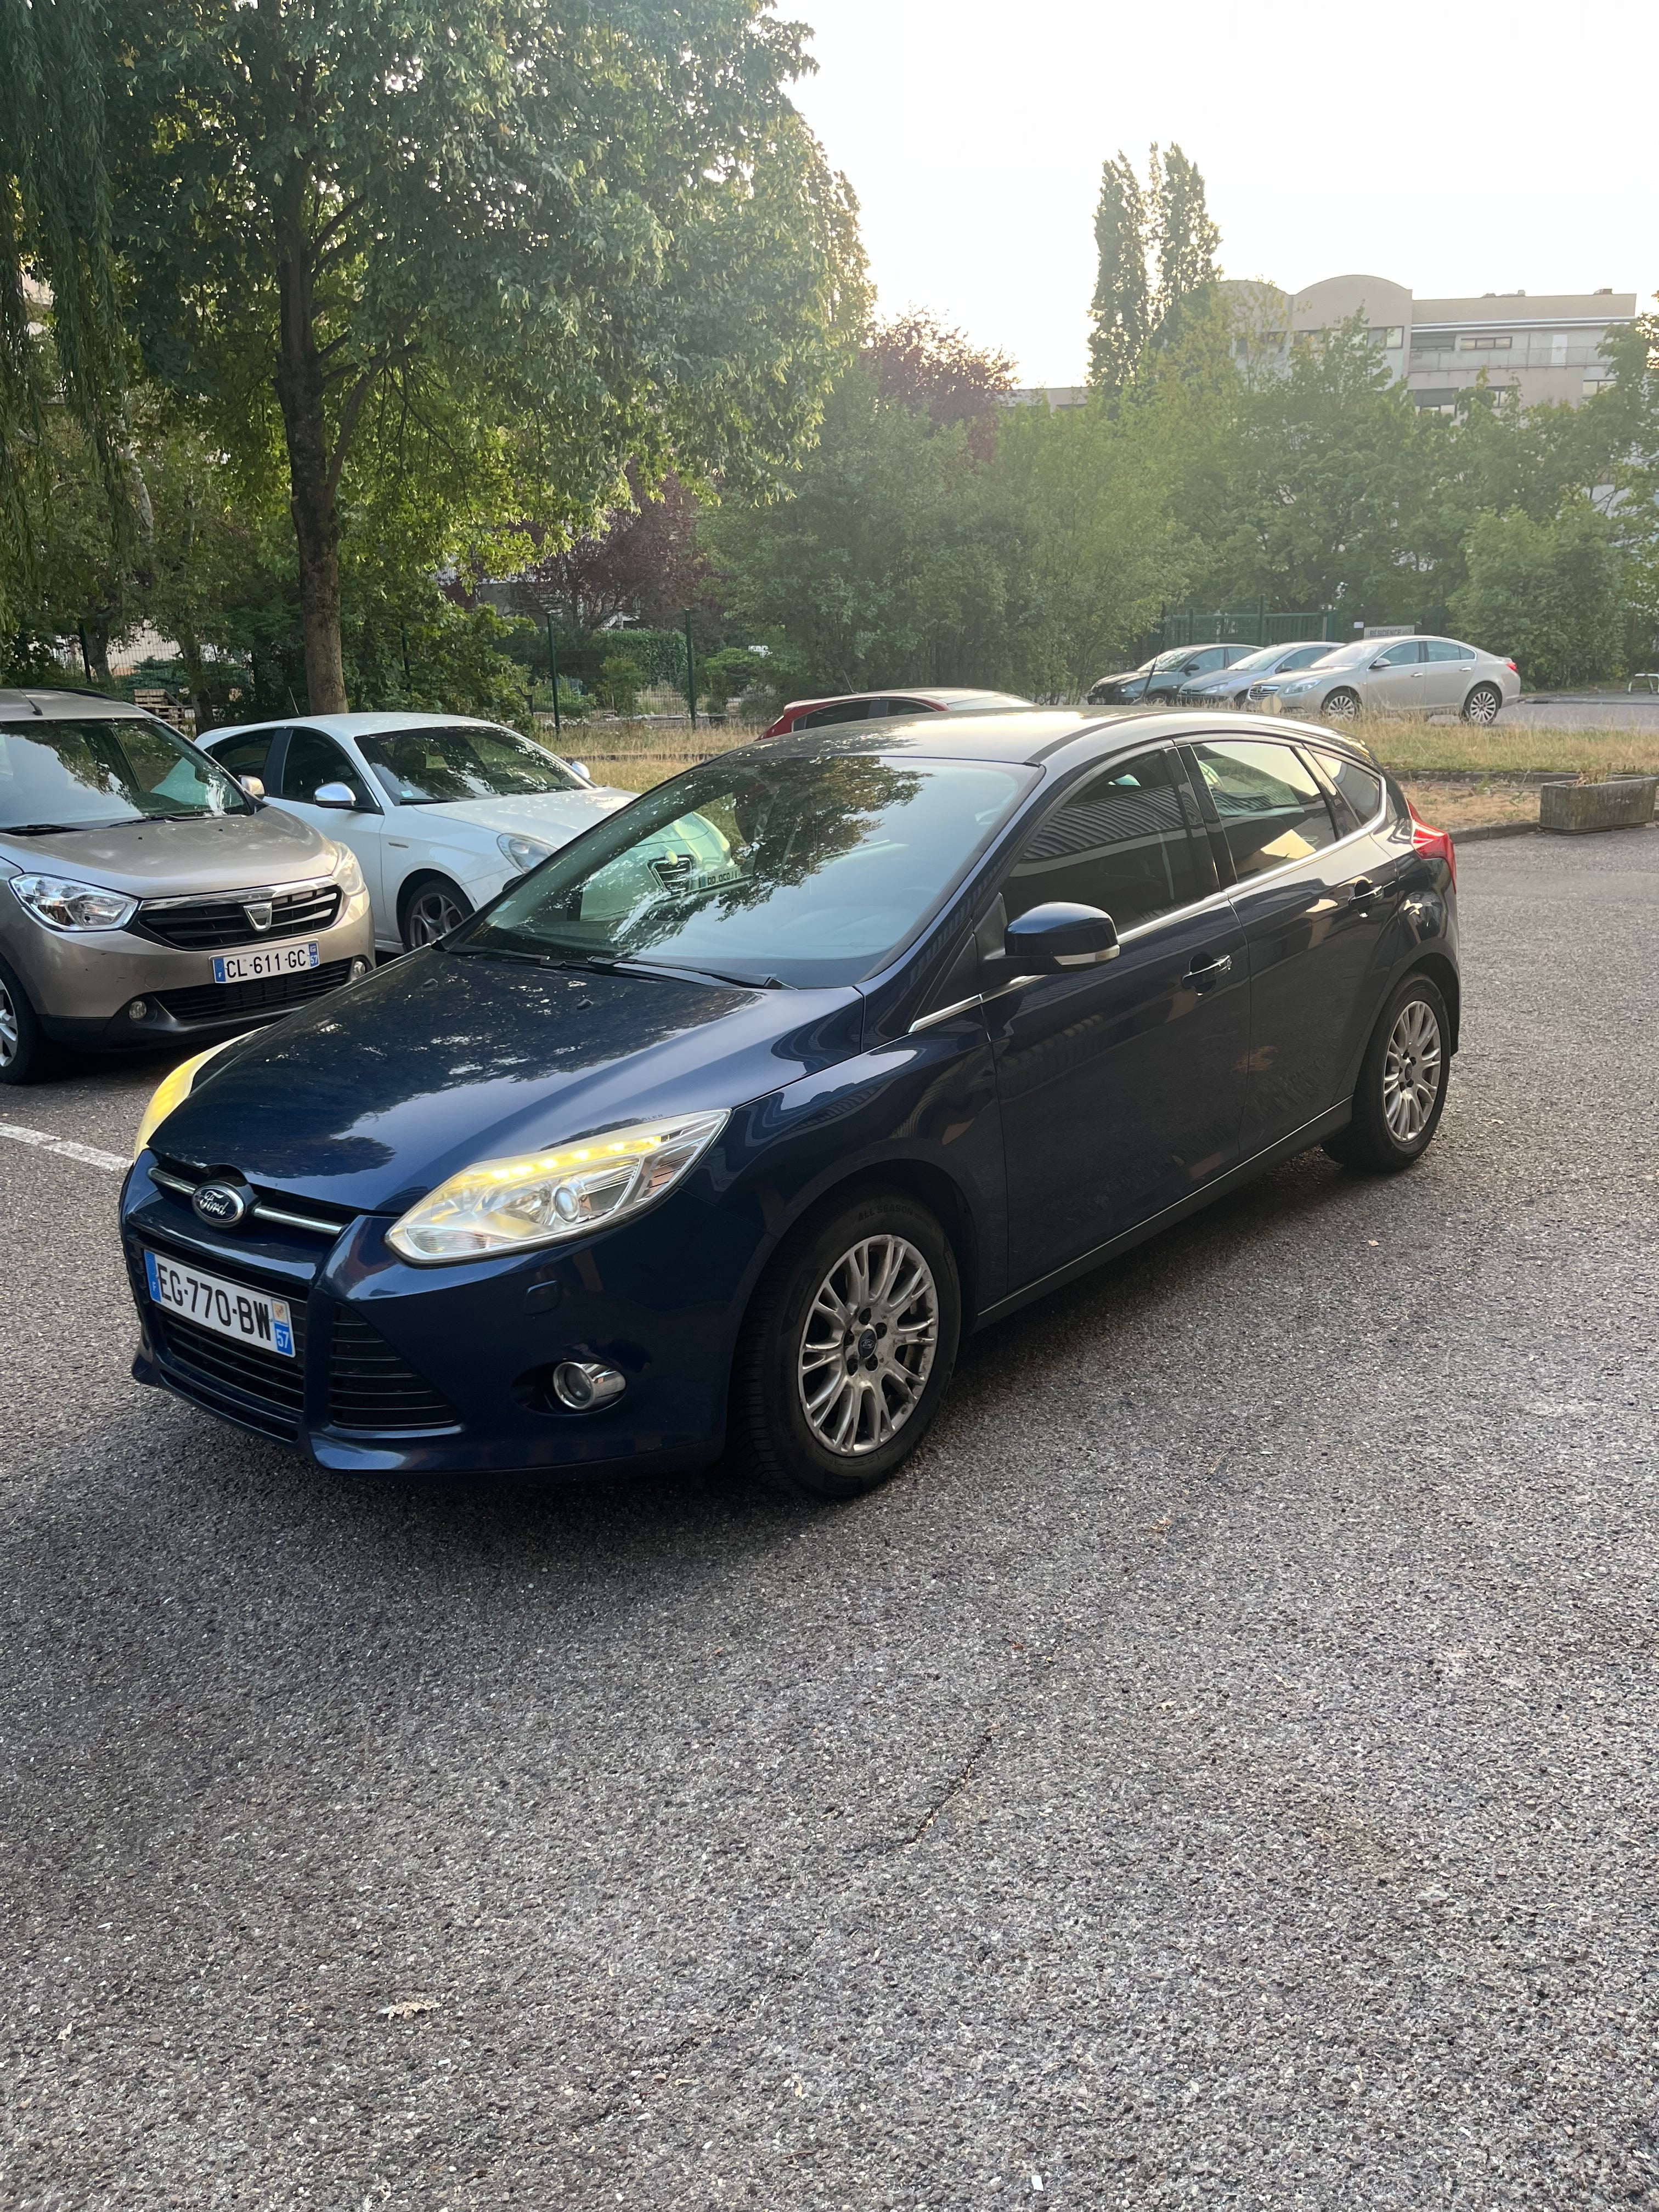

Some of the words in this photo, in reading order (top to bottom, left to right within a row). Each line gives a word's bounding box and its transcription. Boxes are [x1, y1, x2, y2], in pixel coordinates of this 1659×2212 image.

[226, 949, 306, 978] CL-611-GC
[310, 955, 318, 964] 57
[200, 1190, 229, 1216] Ford
[152, 1281, 156, 1291] F
[157, 1263, 272, 1341] EG-770-BW
[276, 1328, 289, 1348] 57
